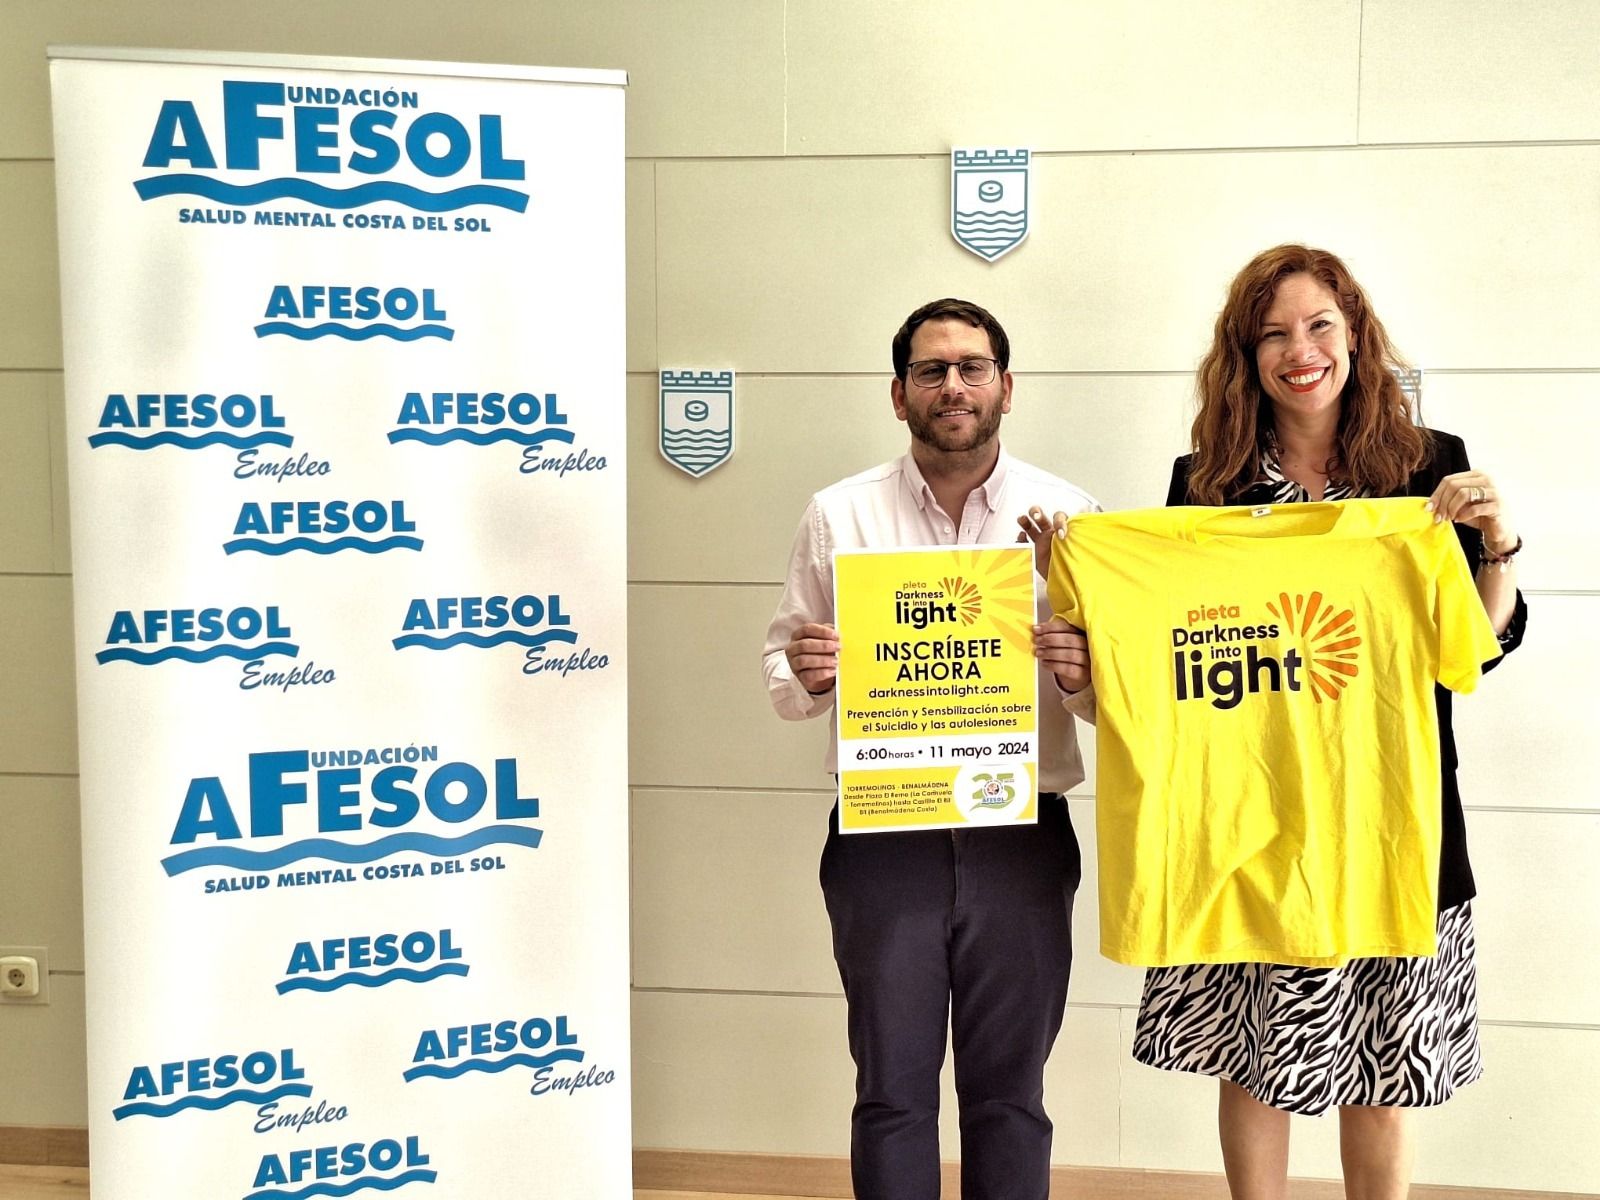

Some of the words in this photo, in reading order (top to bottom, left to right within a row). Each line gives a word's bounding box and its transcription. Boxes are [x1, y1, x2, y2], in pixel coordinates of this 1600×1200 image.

[142, 80, 525, 181] AFESOL
[179, 208, 247, 226] SALUD
[254, 211, 336, 228] MENTAL
[343, 214, 406, 230] COSTA
[413, 216, 448, 232] DEL
[454, 217, 491, 233] SOL
[265, 285, 447, 322] AFESOL
[98, 394, 286, 429] AFESOL
[397, 393, 568, 426] AFESOL
[234, 448, 331, 482] Empleo
[520, 445, 608, 478] Empleo
[233, 500, 416, 535] AFESOL
[896, 590, 944, 600] Darkness
[106, 606, 291, 644] AFESOL
[402, 594, 571, 631] AFESOL
[896, 601, 956, 630] light
[1187, 604, 1240, 627] pieta
[876, 635, 1002, 662] INSCRÍBETE
[1172, 623, 1280, 647] Darkness
[522, 646, 609, 678] Empleo
[1210, 646, 1241, 659] into
[240, 659, 336, 692] Empleo
[896, 661, 982, 682] AHORA
[1174, 645, 1302, 710] light
[869, 684, 1010, 699] darknessintolight.com
[847, 706, 909, 719] Prevención
[912, 709, 919, 718] y
[1001, 703, 1032, 714] sobre
[862, 723, 872, 732] el
[875, 721, 918, 732] Suicidio
[921, 723, 928, 732] y
[930, 721, 946, 730] las
[949, 718, 1017, 729] autolesiones
[929, 745, 943, 758] 11
[951, 745, 992, 760] mayo
[998, 742, 1030, 756] 2024
[170, 750, 539, 844] AFESOL
[204, 877, 270, 894] SALUD
[277, 868, 356, 888] MENTAL
[363, 863, 424, 881] COSTA
[430, 859, 465, 876] DEL
[470, 855, 506, 872] SOL
[286, 929, 463, 975] AFESOL
[412, 1016, 578, 1063] AFESOL
[123, 1048, 305, 1100] AFESOL
[530, 1065, 616, 1096] Empleo
[254, 1101, 348, 1134] Empleo
[252, 1135, 430, 1188] AFESOL
